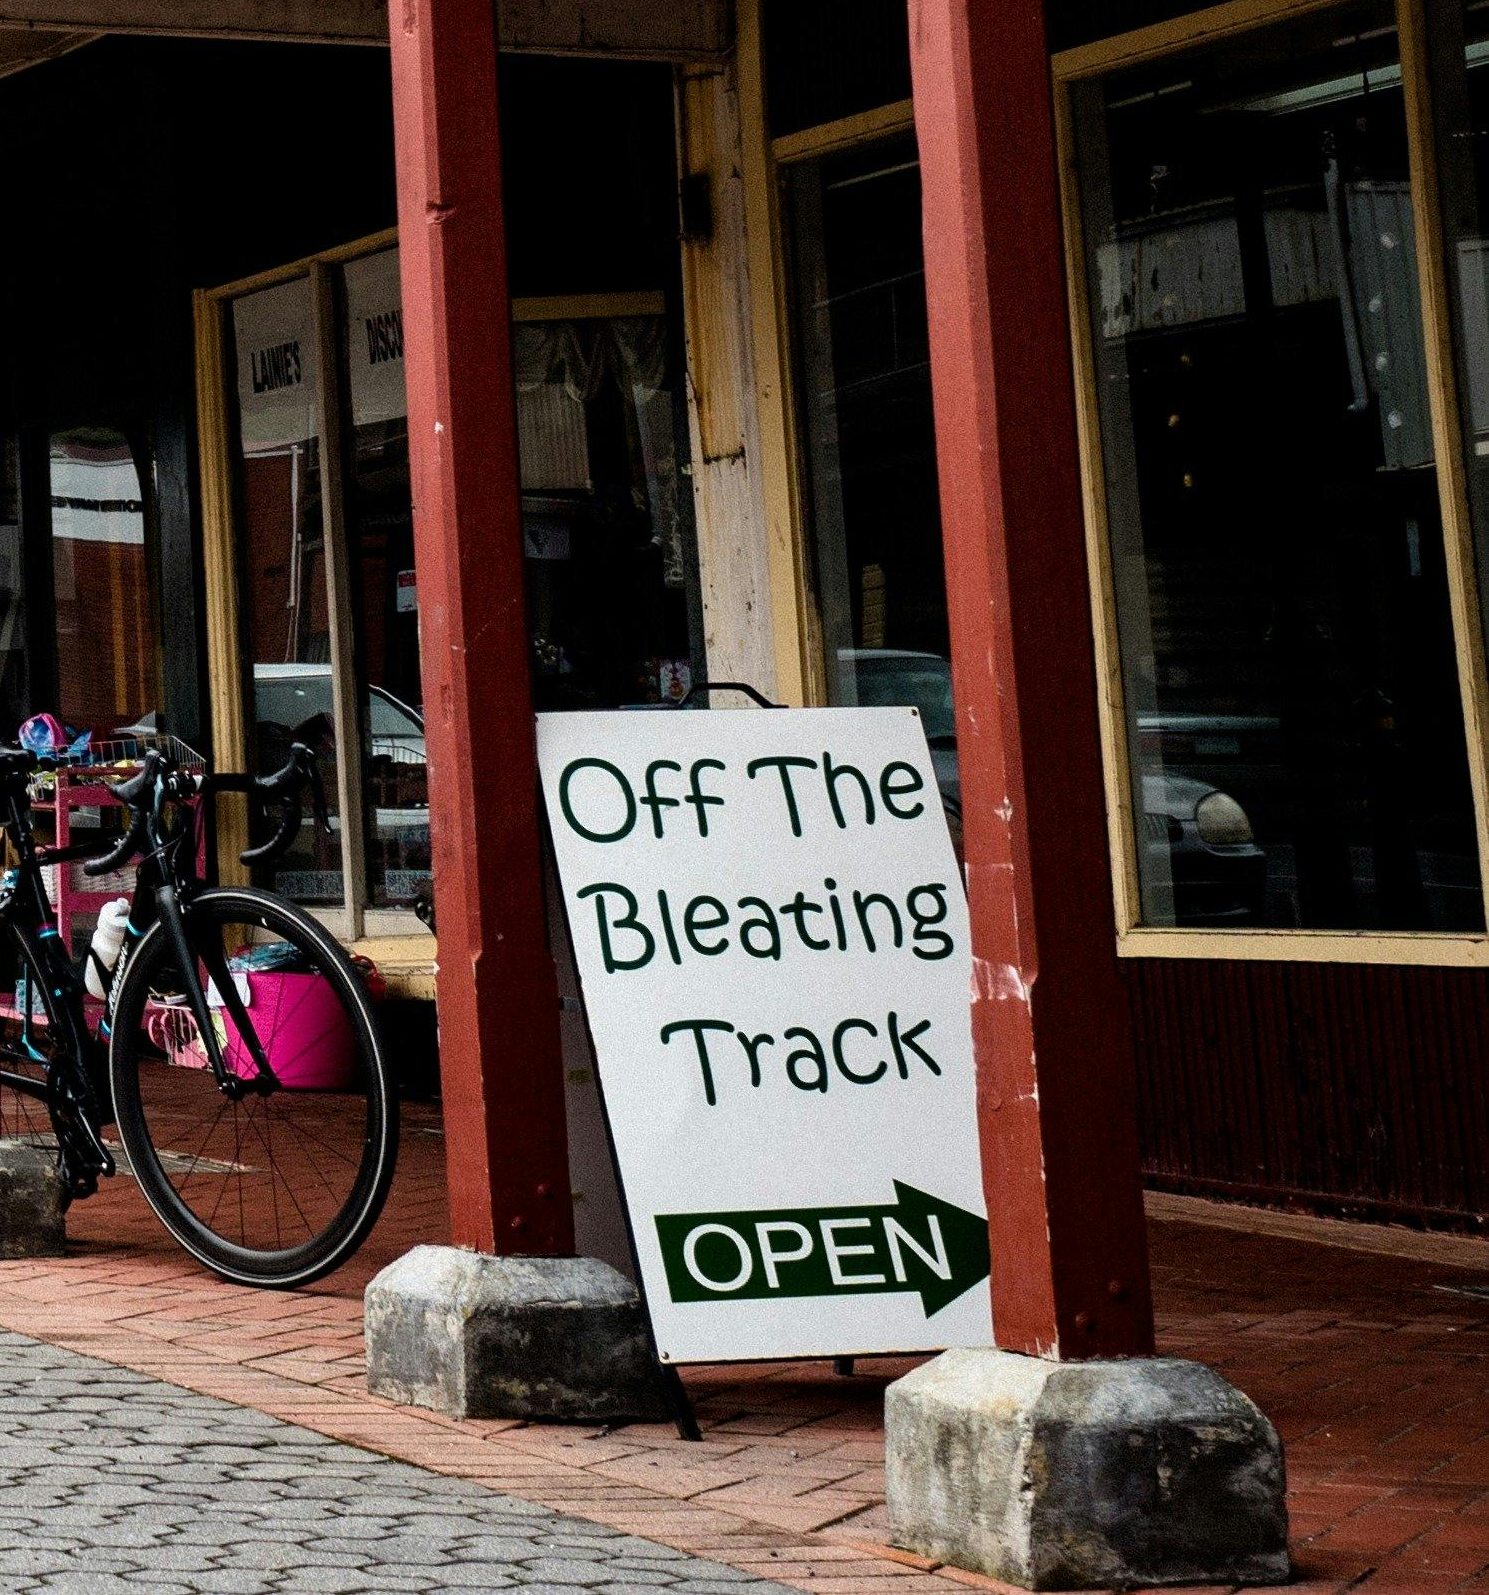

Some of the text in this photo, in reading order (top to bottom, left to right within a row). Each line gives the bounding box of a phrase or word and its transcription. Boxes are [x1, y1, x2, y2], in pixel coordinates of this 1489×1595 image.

[558, 751, 925, 844] Off The
[576, 878, 954, 974] Bleating
[659, 1012, 943, 1106] Track
[682, 1214, 952, 1292] OPEN
